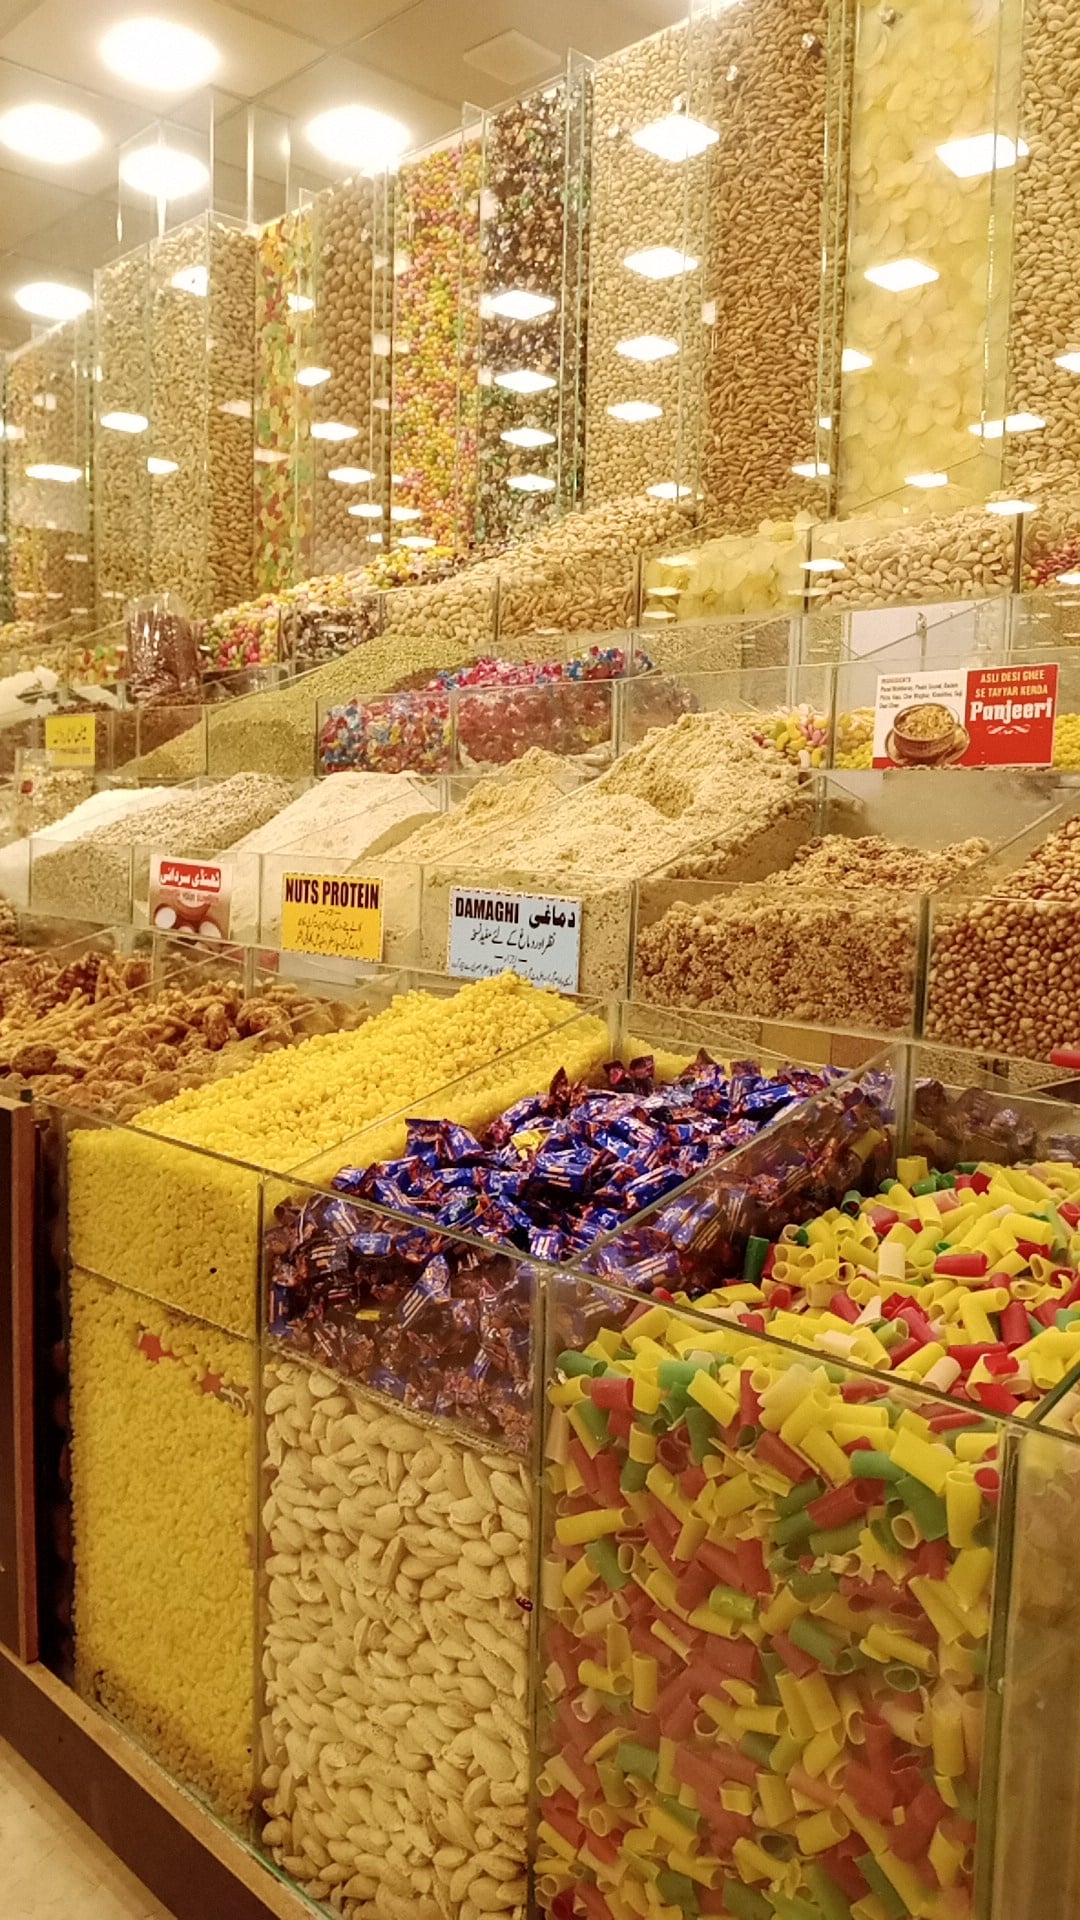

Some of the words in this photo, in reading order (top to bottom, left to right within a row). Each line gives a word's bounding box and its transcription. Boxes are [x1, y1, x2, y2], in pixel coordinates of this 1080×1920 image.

[980, 673, 999, 683] ASLI
[1001, 671, 1021, 682] DESI
[1022, 670, 1044, 681] GHEE
[975, 688, 986, 698] SE
[988, 686, 1018, 698] TAYYAR
[1020, 684, 1048, 696] KERDA
[969, 697, 1053, 724] Panjeeri
[285, 878, 319, 905] NUTS
[322, 880, 379, 910] PROTEIN
[455, 897, 519, 924] DAMAGHI
[528, 904, 576, 929] دماغی
